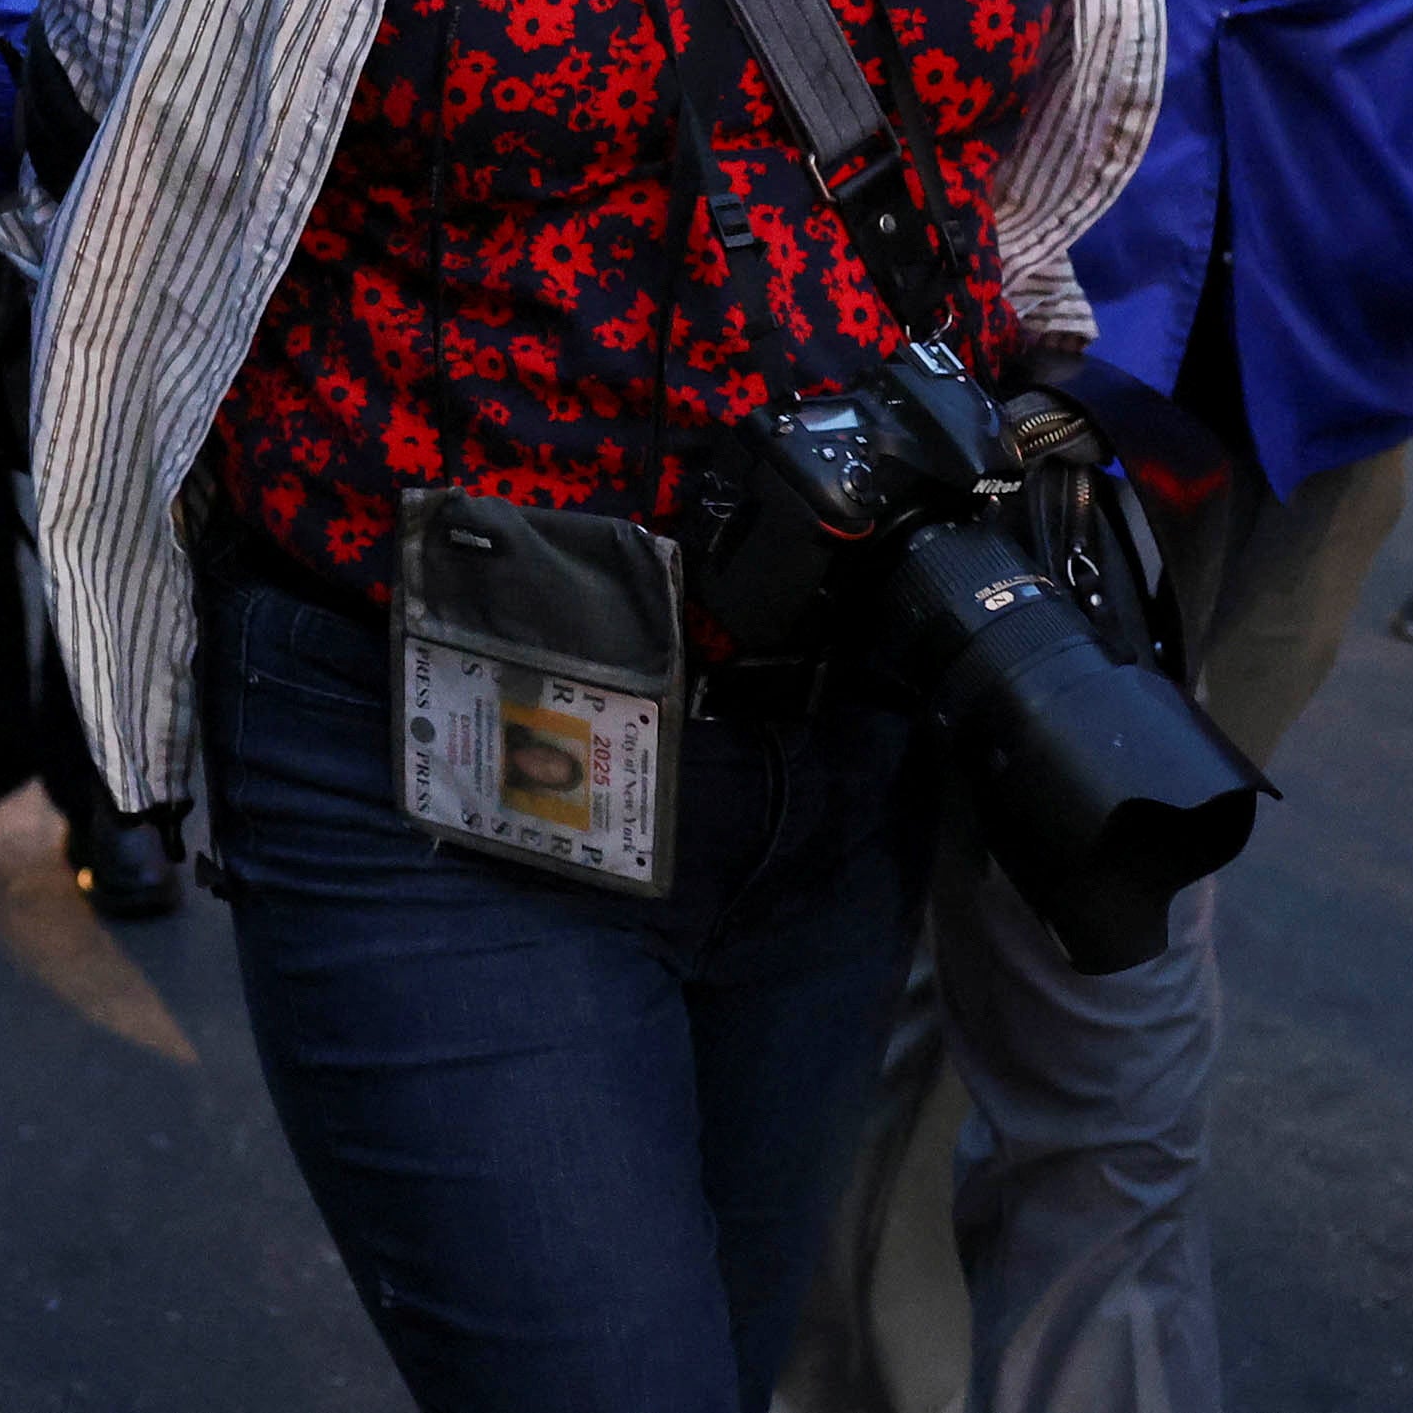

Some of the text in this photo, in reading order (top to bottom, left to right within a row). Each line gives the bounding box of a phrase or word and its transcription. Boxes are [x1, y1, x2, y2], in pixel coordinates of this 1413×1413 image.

[972, 479, 1022, 494] Nikon
[415, 646, 431, 709] PRESS
[415, 750, 431, 814] PRESS
[593, 733, 612, 787] 2025
[622, 722, 638, 854] City of New York
